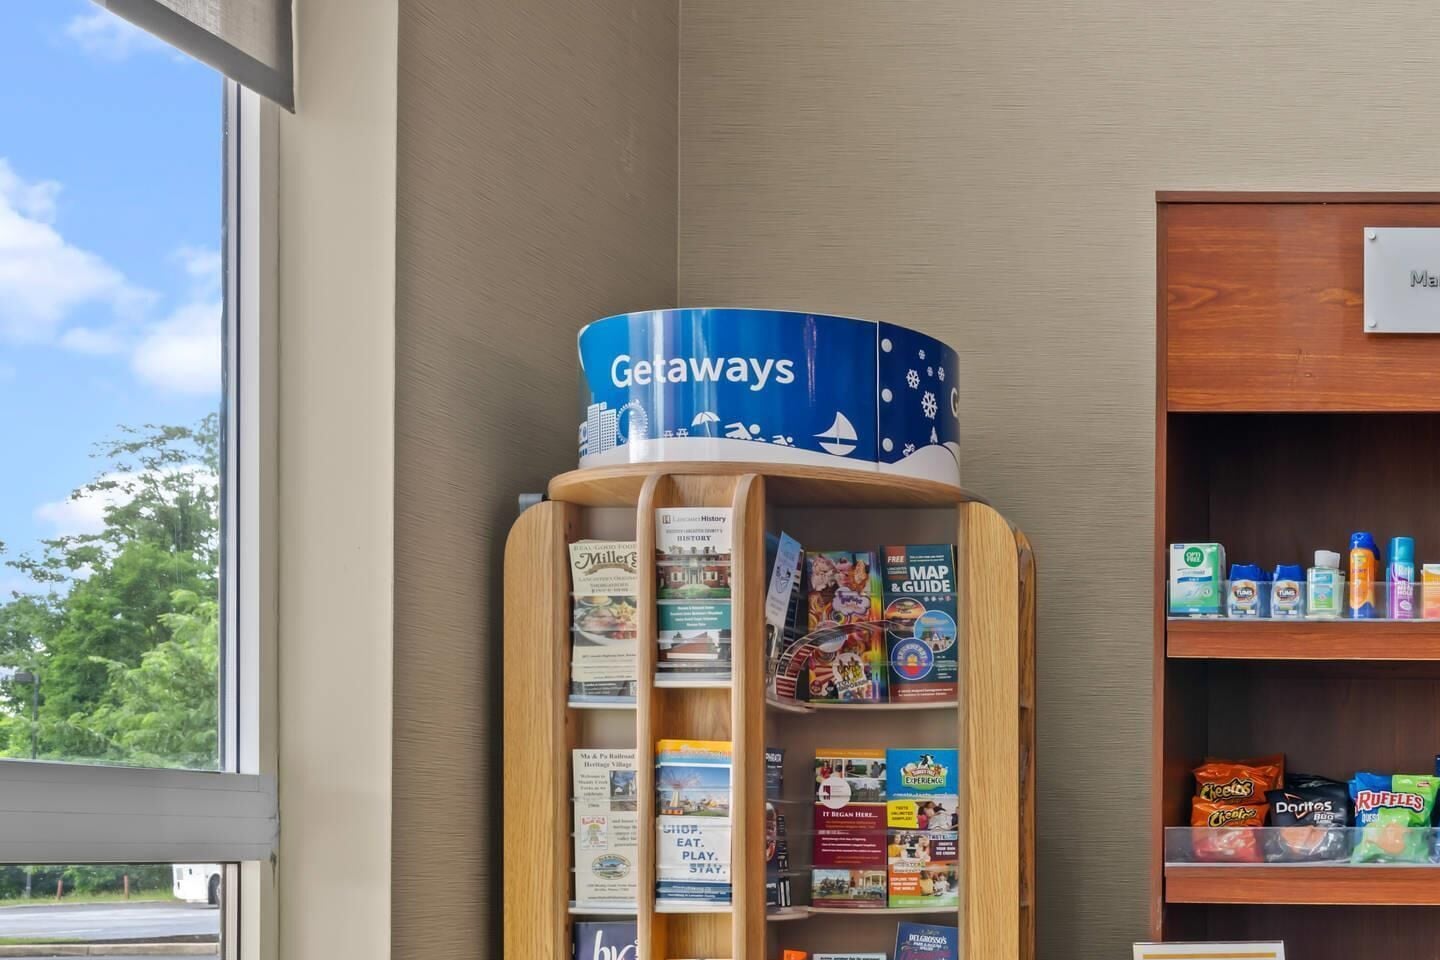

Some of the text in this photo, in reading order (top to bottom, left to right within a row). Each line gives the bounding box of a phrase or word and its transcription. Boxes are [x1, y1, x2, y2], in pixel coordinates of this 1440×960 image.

[611, 353, 795, 391] Getaways
[909, 566, 948, 580] MAP
[891, 580, 951, 593] & GUIDE
[1201, 778, 1254, 801] Cheetos
[1355, 790, 1424, 811] RUFFLES
[1276, 801, 1332, 815] Doritos
[1209, 807, 1256, 827] Cheetos
[677, 839, 704, 847] EAT.
[682, 852, 718, 861] PLAY.
[689, 864, 726, 874] STAY.
[909, 934, 947, 945] DELGROSSO'S
